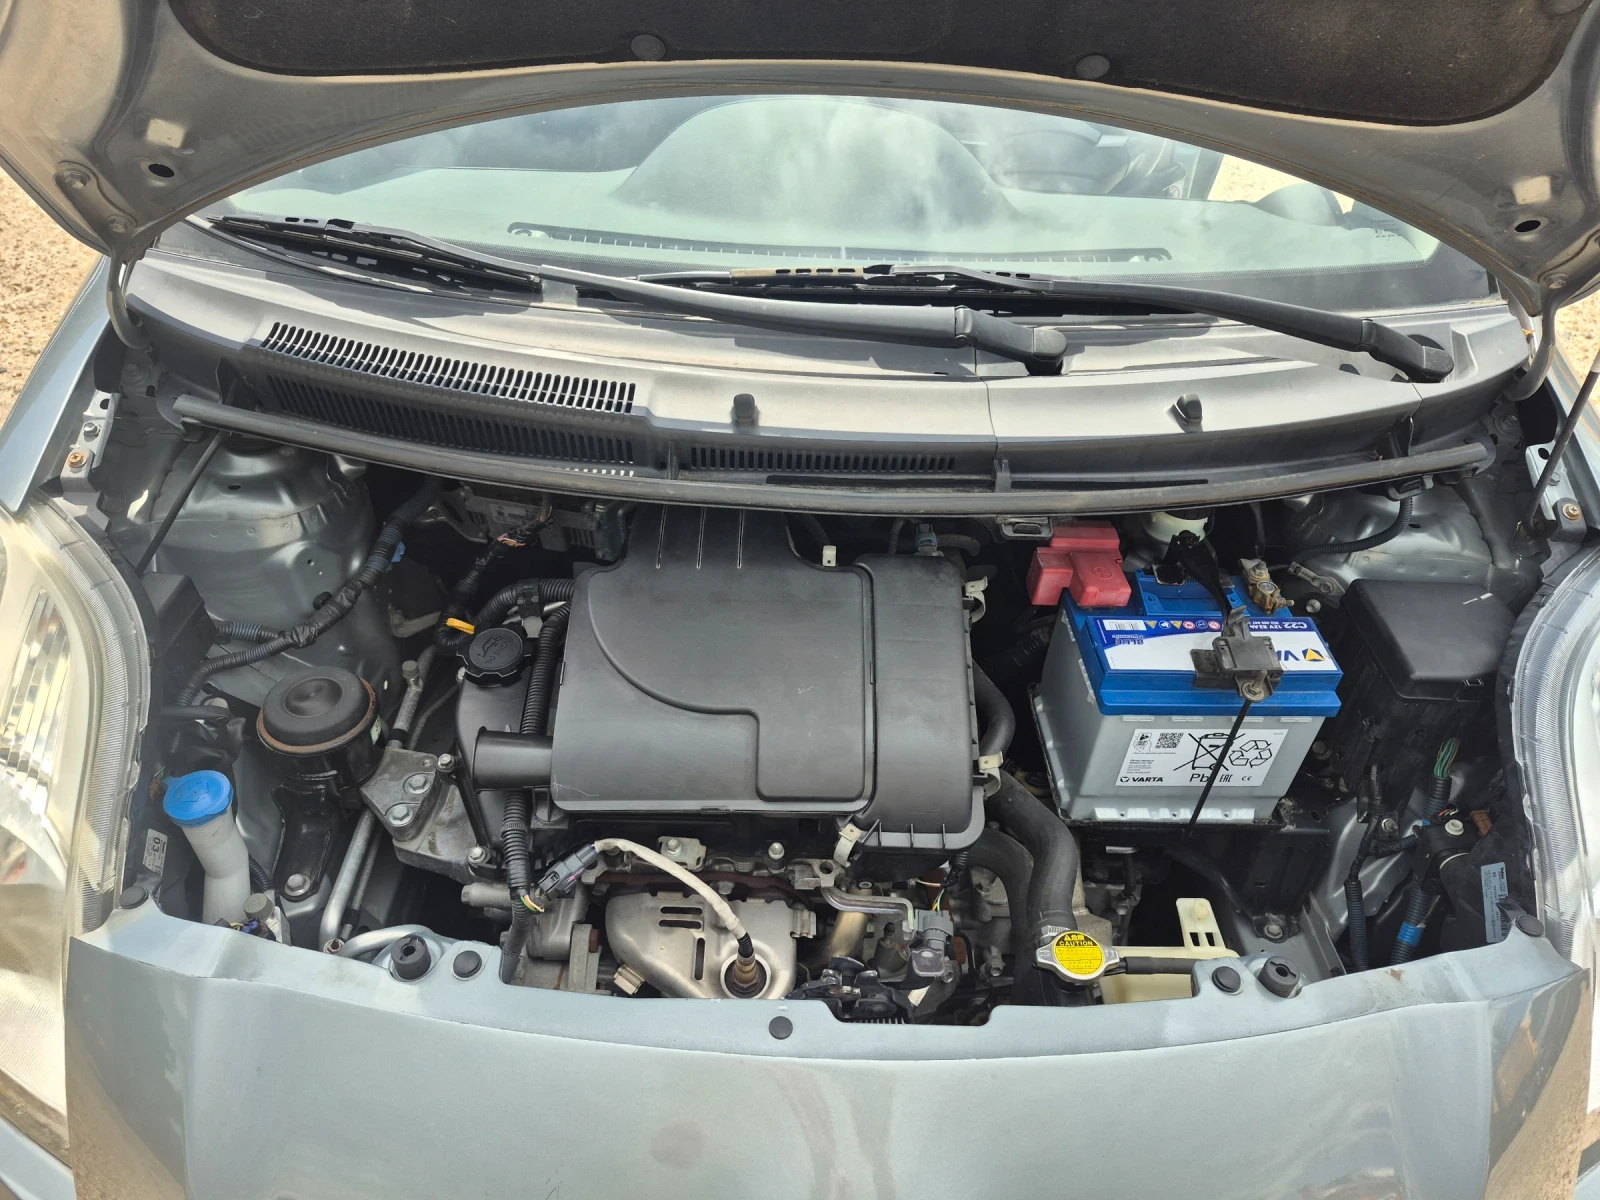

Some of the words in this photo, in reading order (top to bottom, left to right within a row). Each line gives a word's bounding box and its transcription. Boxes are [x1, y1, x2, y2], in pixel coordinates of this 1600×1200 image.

[1282, 621, 1308, 629] C22
[1189, 774, 1209, 782] Pb
[153, 837, 160, 852] 03
